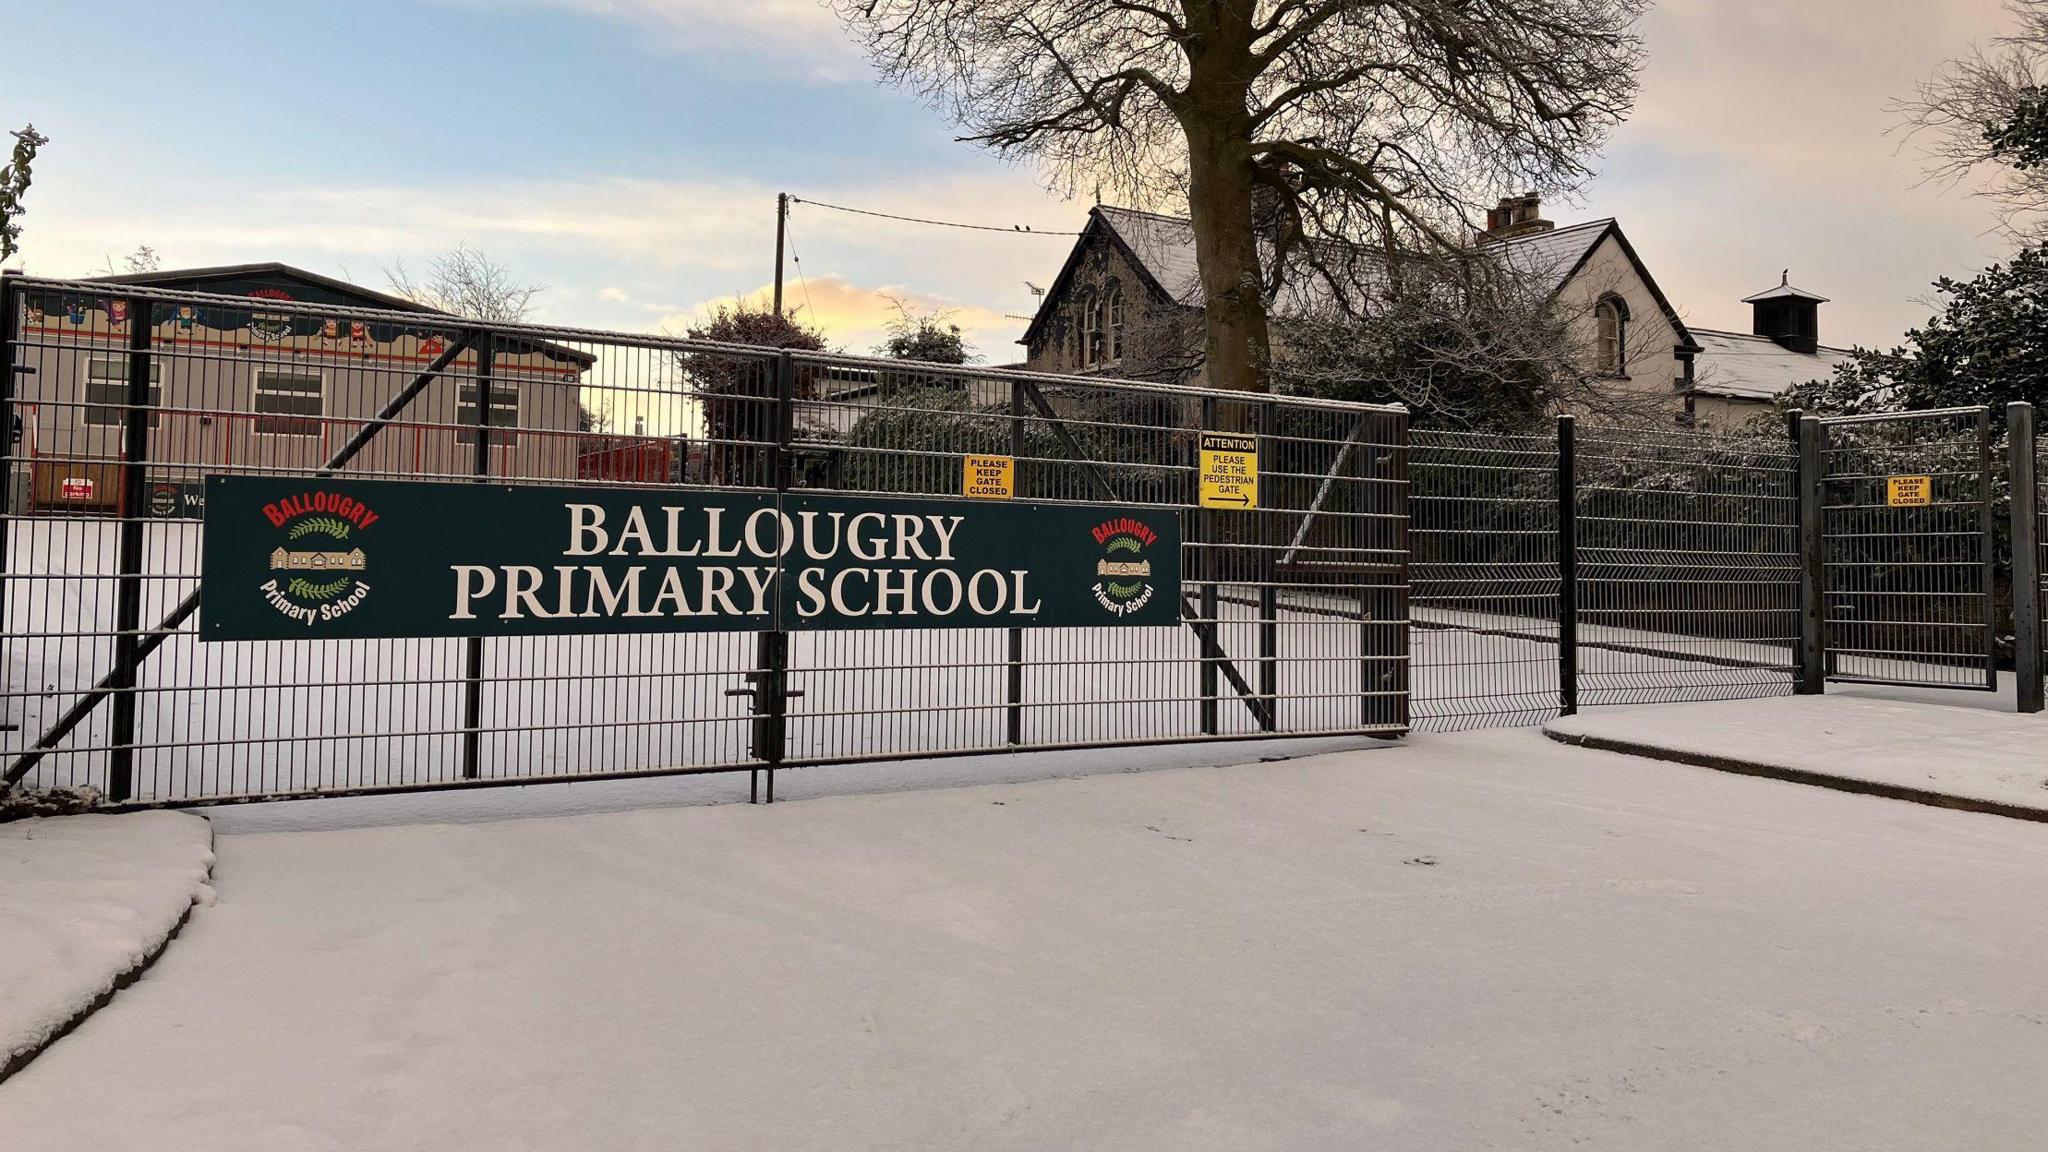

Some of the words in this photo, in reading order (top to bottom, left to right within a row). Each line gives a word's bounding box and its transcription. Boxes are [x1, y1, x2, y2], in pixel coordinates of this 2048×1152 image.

[1203, 437, 1254, 450] ATTENTION
[971, 460, 1007, 468] PLEASE
[1213, 455, 1245, 465] PLEASE
[1212, 465, 1228, 474] USE
[1231, 466, 1246, 475] THE
[976, 478, 1001, 486] GATE
[1204, 475, 1254, 485] PEDESTRIAN
[970, 487, 1007, 495] CLOSED
[1219, 486, 1239, 494] GATE
[263, 491, 379, 530] BALLOUGRY
[562, 503, 964, 561] BALLOUGRY
[1092, 518, 1158, 546] BALLOUGRY
[449, 565, 785, 619] PRIMARY
[796, 567, 1041, 617] SCHOOL
[260, 579, 317, 626] Primary
[320, 580, 370, 621] School
[1092, 582, 1124, 618] Primary
[1125, 584, 1154, 614] School
